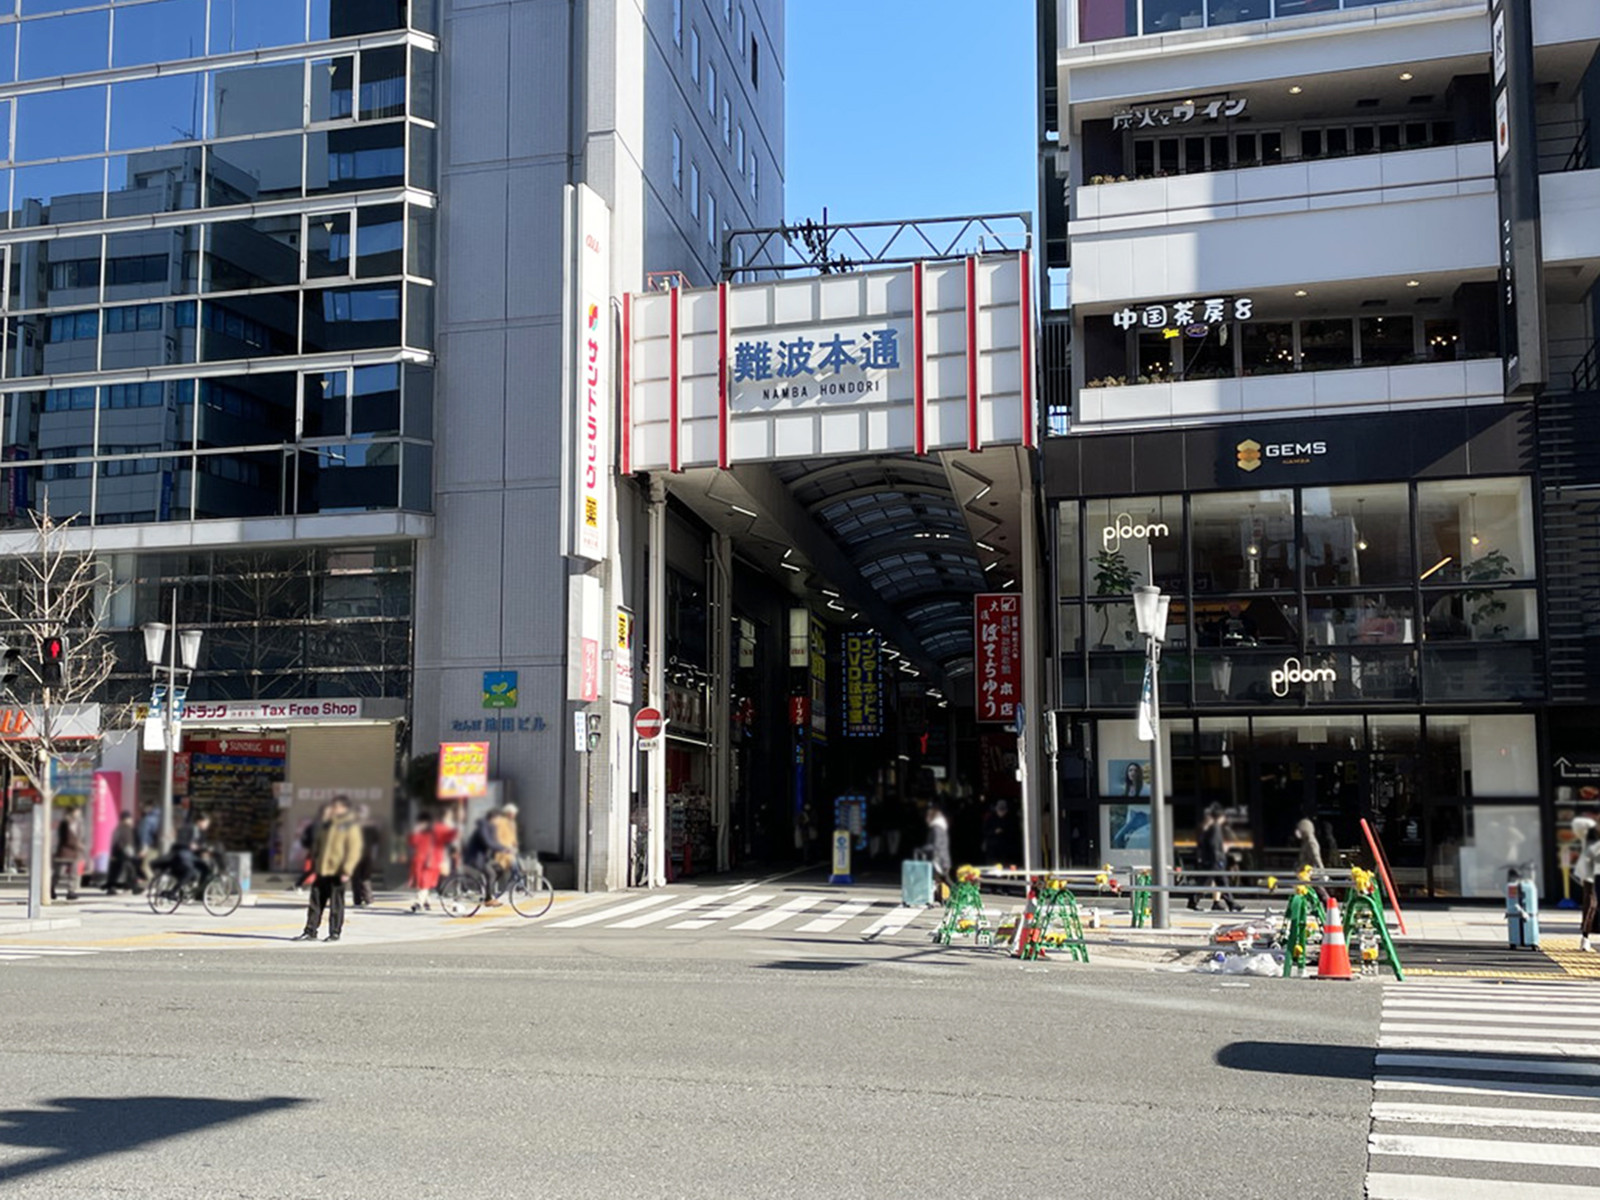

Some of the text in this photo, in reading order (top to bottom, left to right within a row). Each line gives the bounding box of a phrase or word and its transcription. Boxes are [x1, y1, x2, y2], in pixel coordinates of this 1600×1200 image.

[1112, 99, 1248, 131] 炭火とワイン
[1113, 299, 1253, 331] 中国茶房8
[734, 328, 900, 383] 難波本通
[763, 380, 880, 400] NAMBA HONDORI
[587, 338, 599, 489] サンドラッグ
[1265, 441, 1327, 457] GEMS
[1103, 513, 1169, 553] ploom
[1271, 657, 1337, 697] ploom
[261, 704, 284, 716] Tax
[288, 703, 319, 717] Free
[322, 702, 357, 717] Shop
